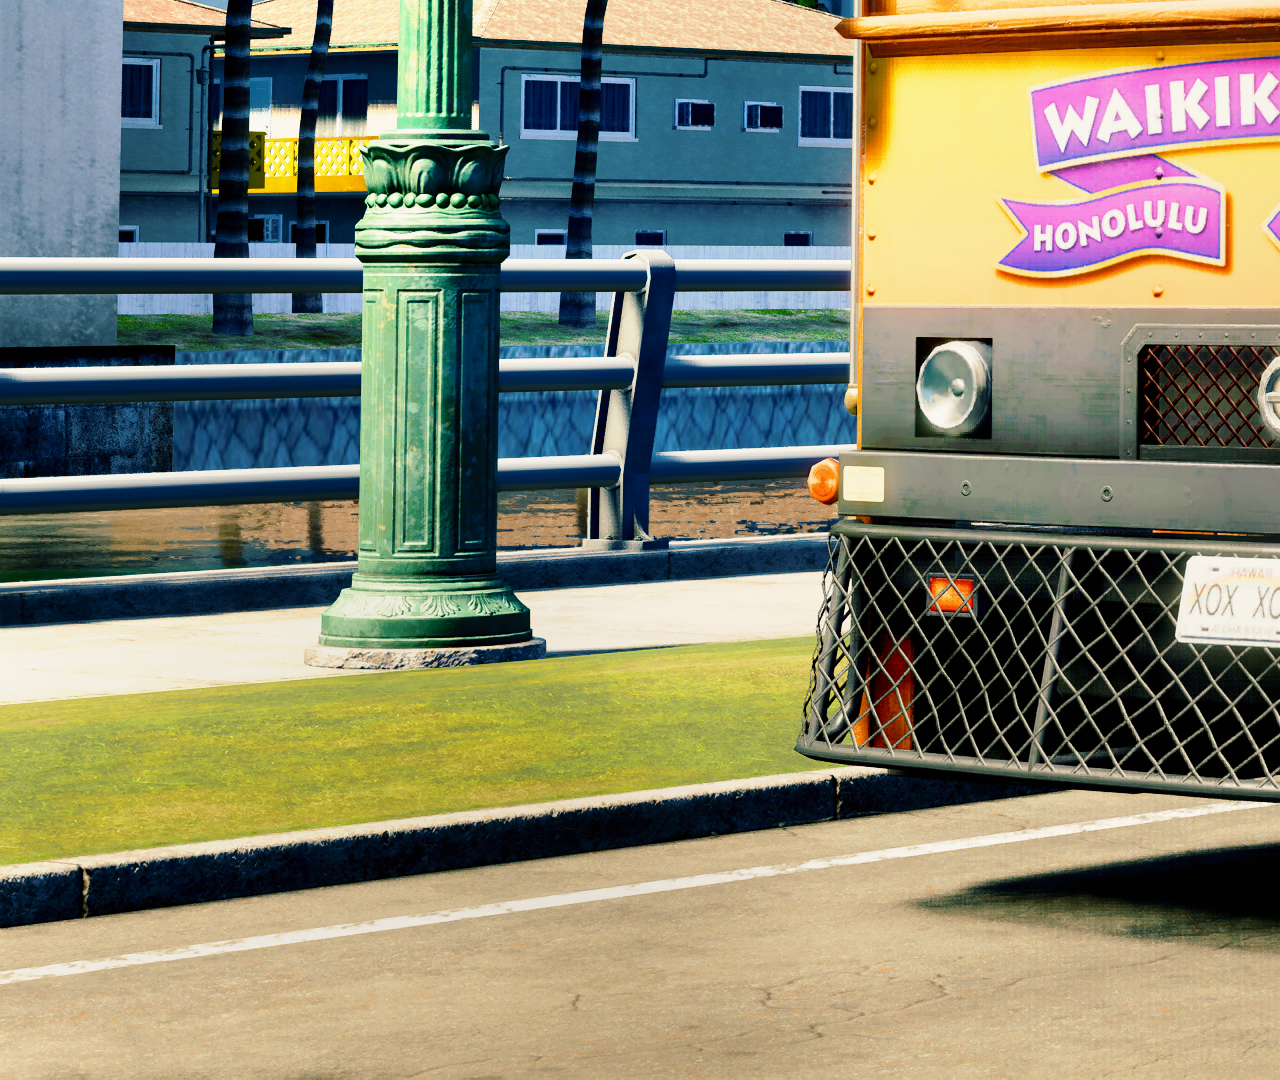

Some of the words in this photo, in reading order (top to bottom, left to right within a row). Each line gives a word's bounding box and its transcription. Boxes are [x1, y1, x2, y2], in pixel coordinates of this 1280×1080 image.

[1033, 200, 1208, 252] HONOLULU
[1230, 568, 1273, 579] HAWAII
[1189, 582, 1239, 616] XOX
